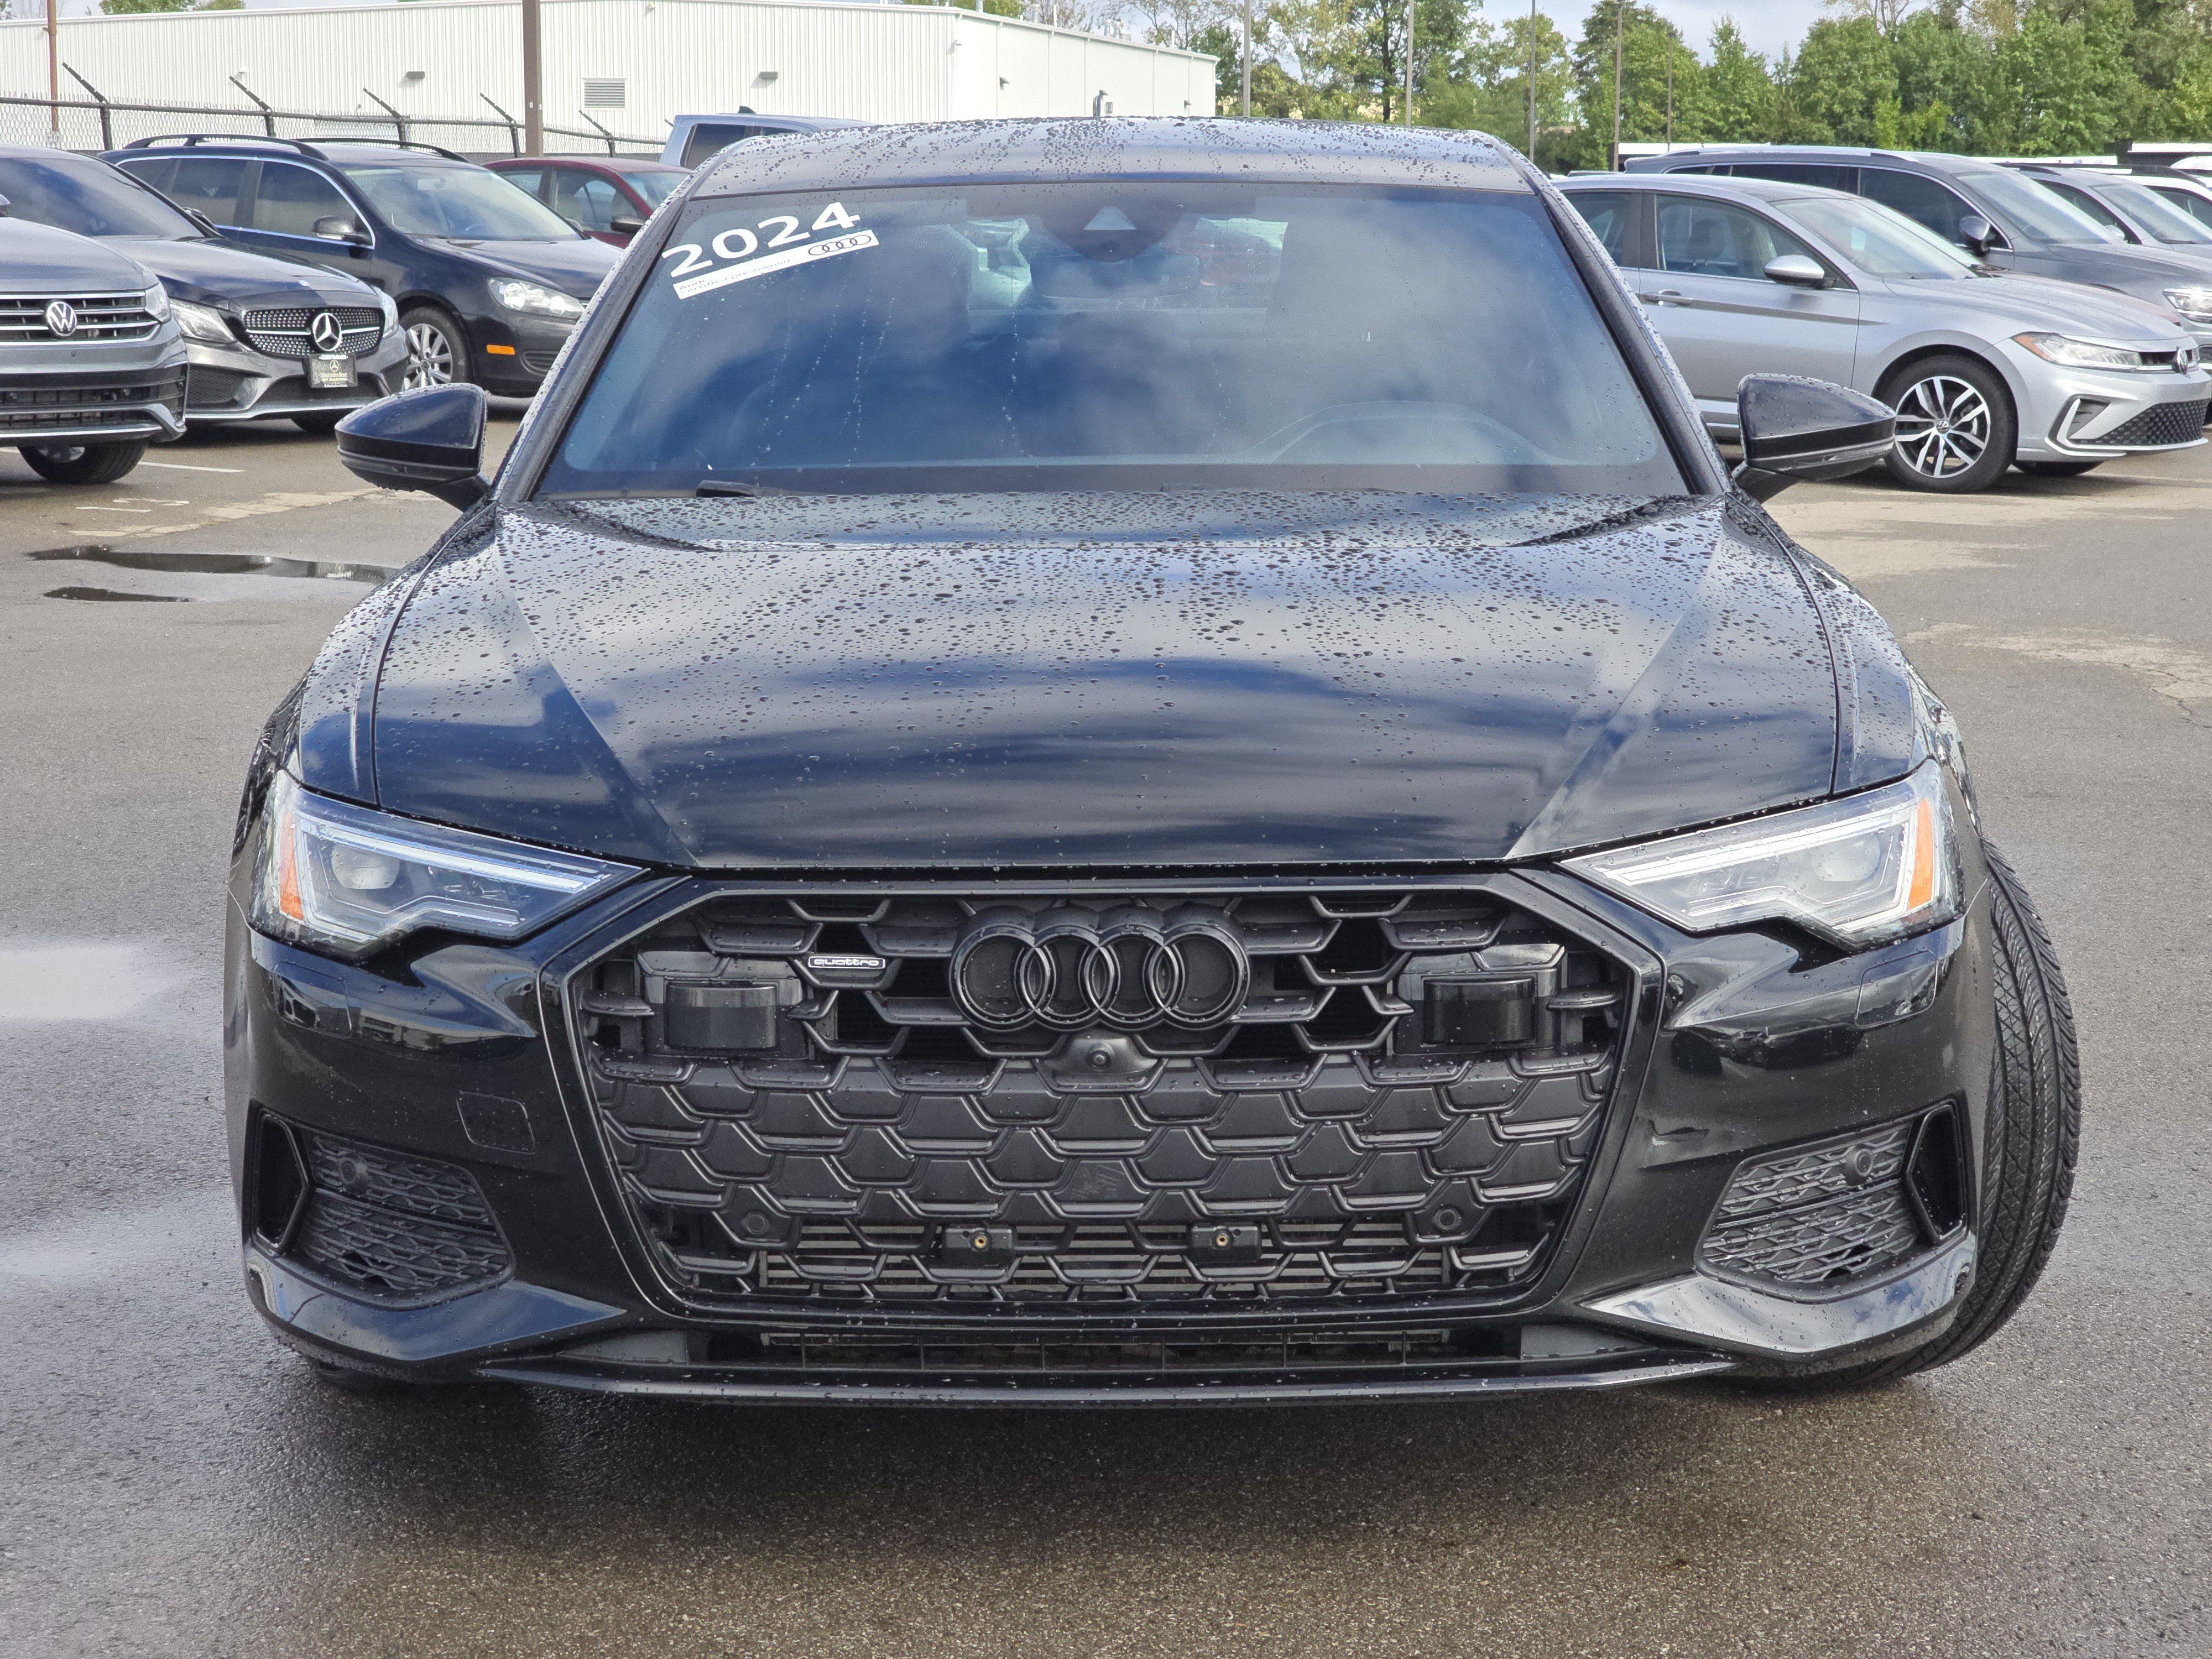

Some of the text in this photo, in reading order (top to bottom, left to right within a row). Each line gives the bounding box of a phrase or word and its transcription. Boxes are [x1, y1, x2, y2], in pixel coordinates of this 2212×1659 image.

[661, 202, 860, 278] 2024
[680, 279, 705, 290] Audi
[813, 958, 880, 967] quattro
